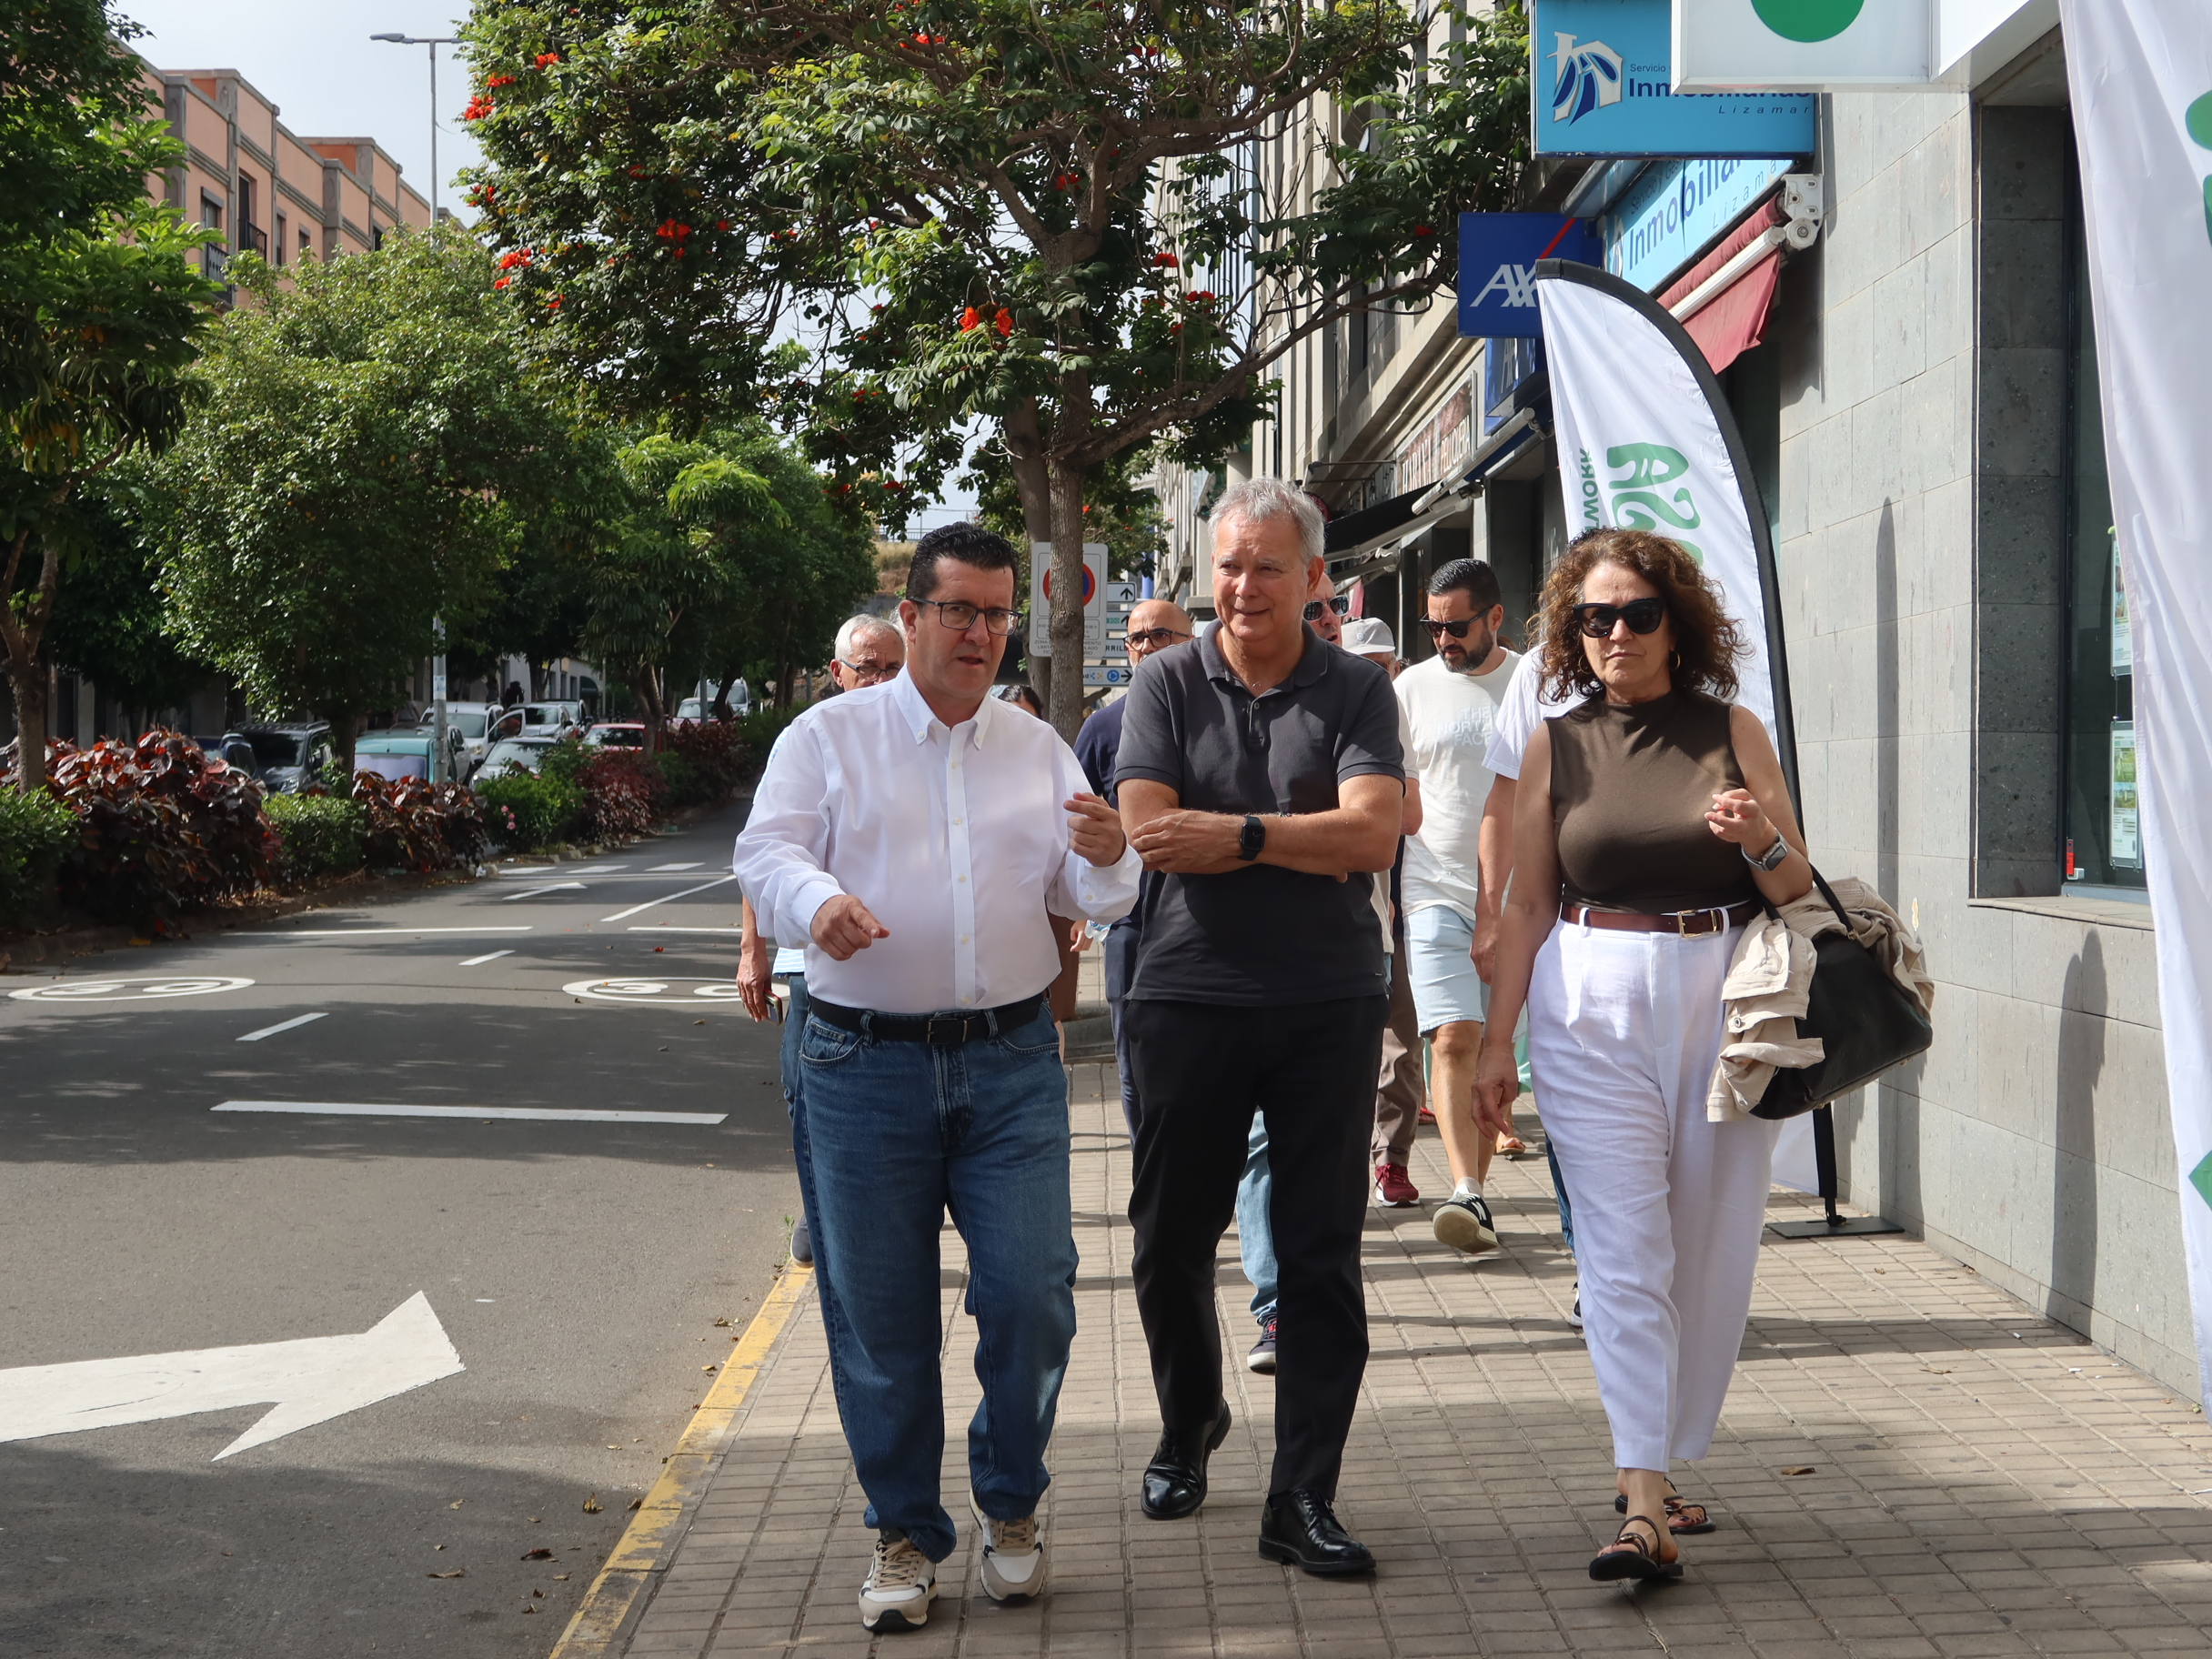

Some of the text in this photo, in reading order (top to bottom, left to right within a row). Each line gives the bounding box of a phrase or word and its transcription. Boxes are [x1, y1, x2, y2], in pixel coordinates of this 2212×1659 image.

[1630, 63, 1666, 72] Servicio
[1718, 105, 1810, 114] Lizamar
[1713, 160, 1780, 229] Lizama
[1470, 265, 1537, 307] AX
[1460, 705, 1491, 720] THE
[1437, 718, 1493, 735] NORTH
[1453, 731, 1492, 746] FACE
